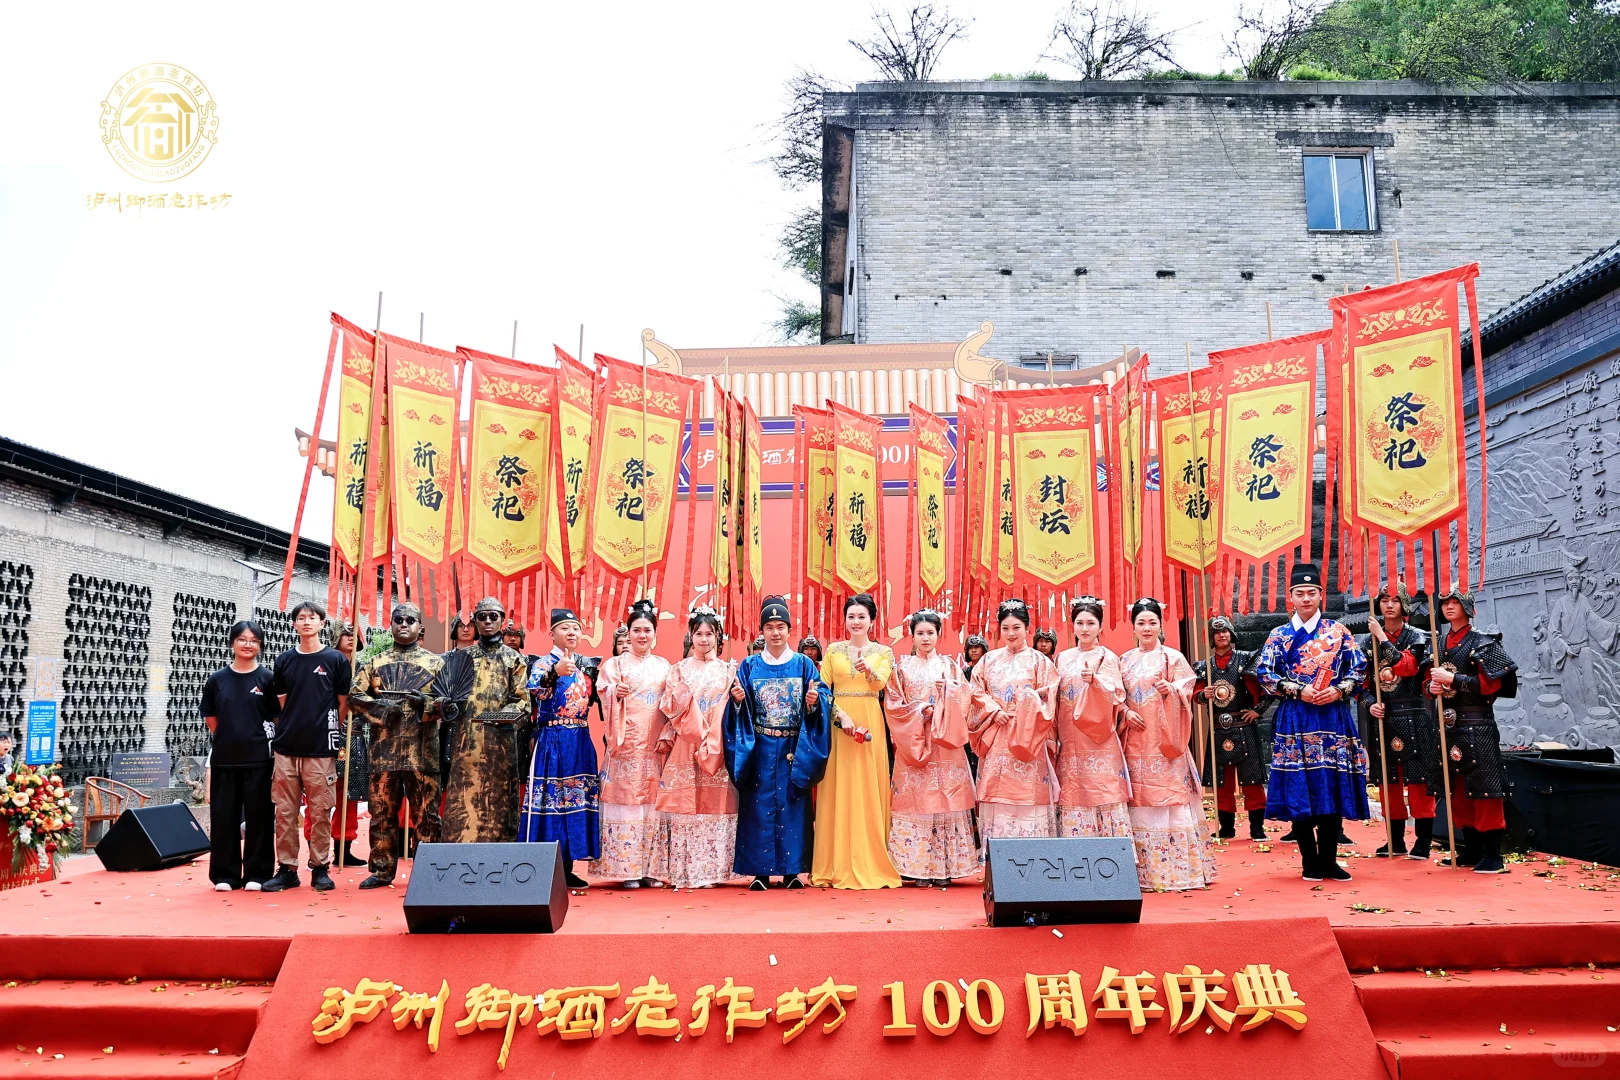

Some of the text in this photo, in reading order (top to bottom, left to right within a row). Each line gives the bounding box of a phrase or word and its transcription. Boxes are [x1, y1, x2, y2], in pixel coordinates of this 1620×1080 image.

[1384, 392, 1427, 470] 祭祀
[413, 440, 444, 512] 祈福
[491, 454, 528, 521] 祭祀
[615, 457, 655, 521] 祭祀
[1183, 456, 1213, 521] 祈福
[1246, 434, 1284, 502] 祭祀
[849, 491, 868, 552] 祈福
[927, 492, 939, 549] 祭祀
[1039, 474, 1071, 535] 封坛
[430, 862, 537, 886] OPRA
[1007, 856, 1120, 882] OPRA
